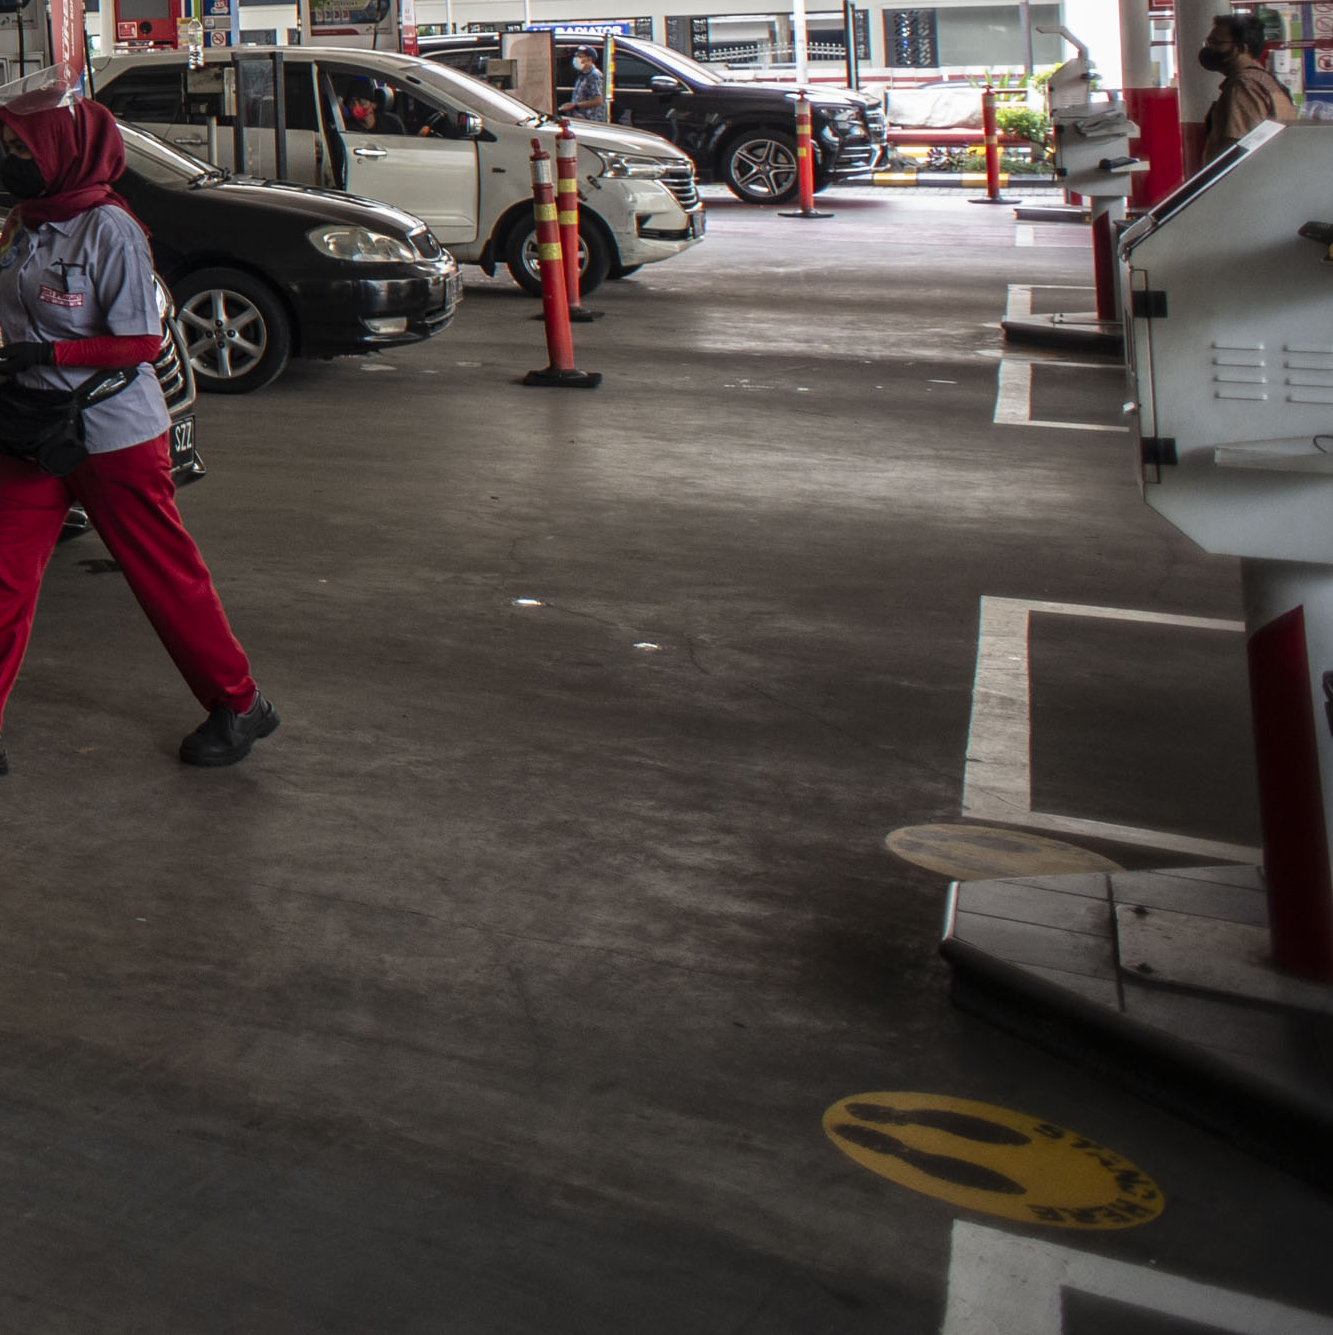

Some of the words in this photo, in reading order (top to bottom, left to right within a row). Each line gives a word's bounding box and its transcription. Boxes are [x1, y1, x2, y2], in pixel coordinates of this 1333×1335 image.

[554, 25, 622, 35] RADIATOR
[175, 421, 192, 453] SZZ
[1027, 1196, 1157, 1226] HERE
